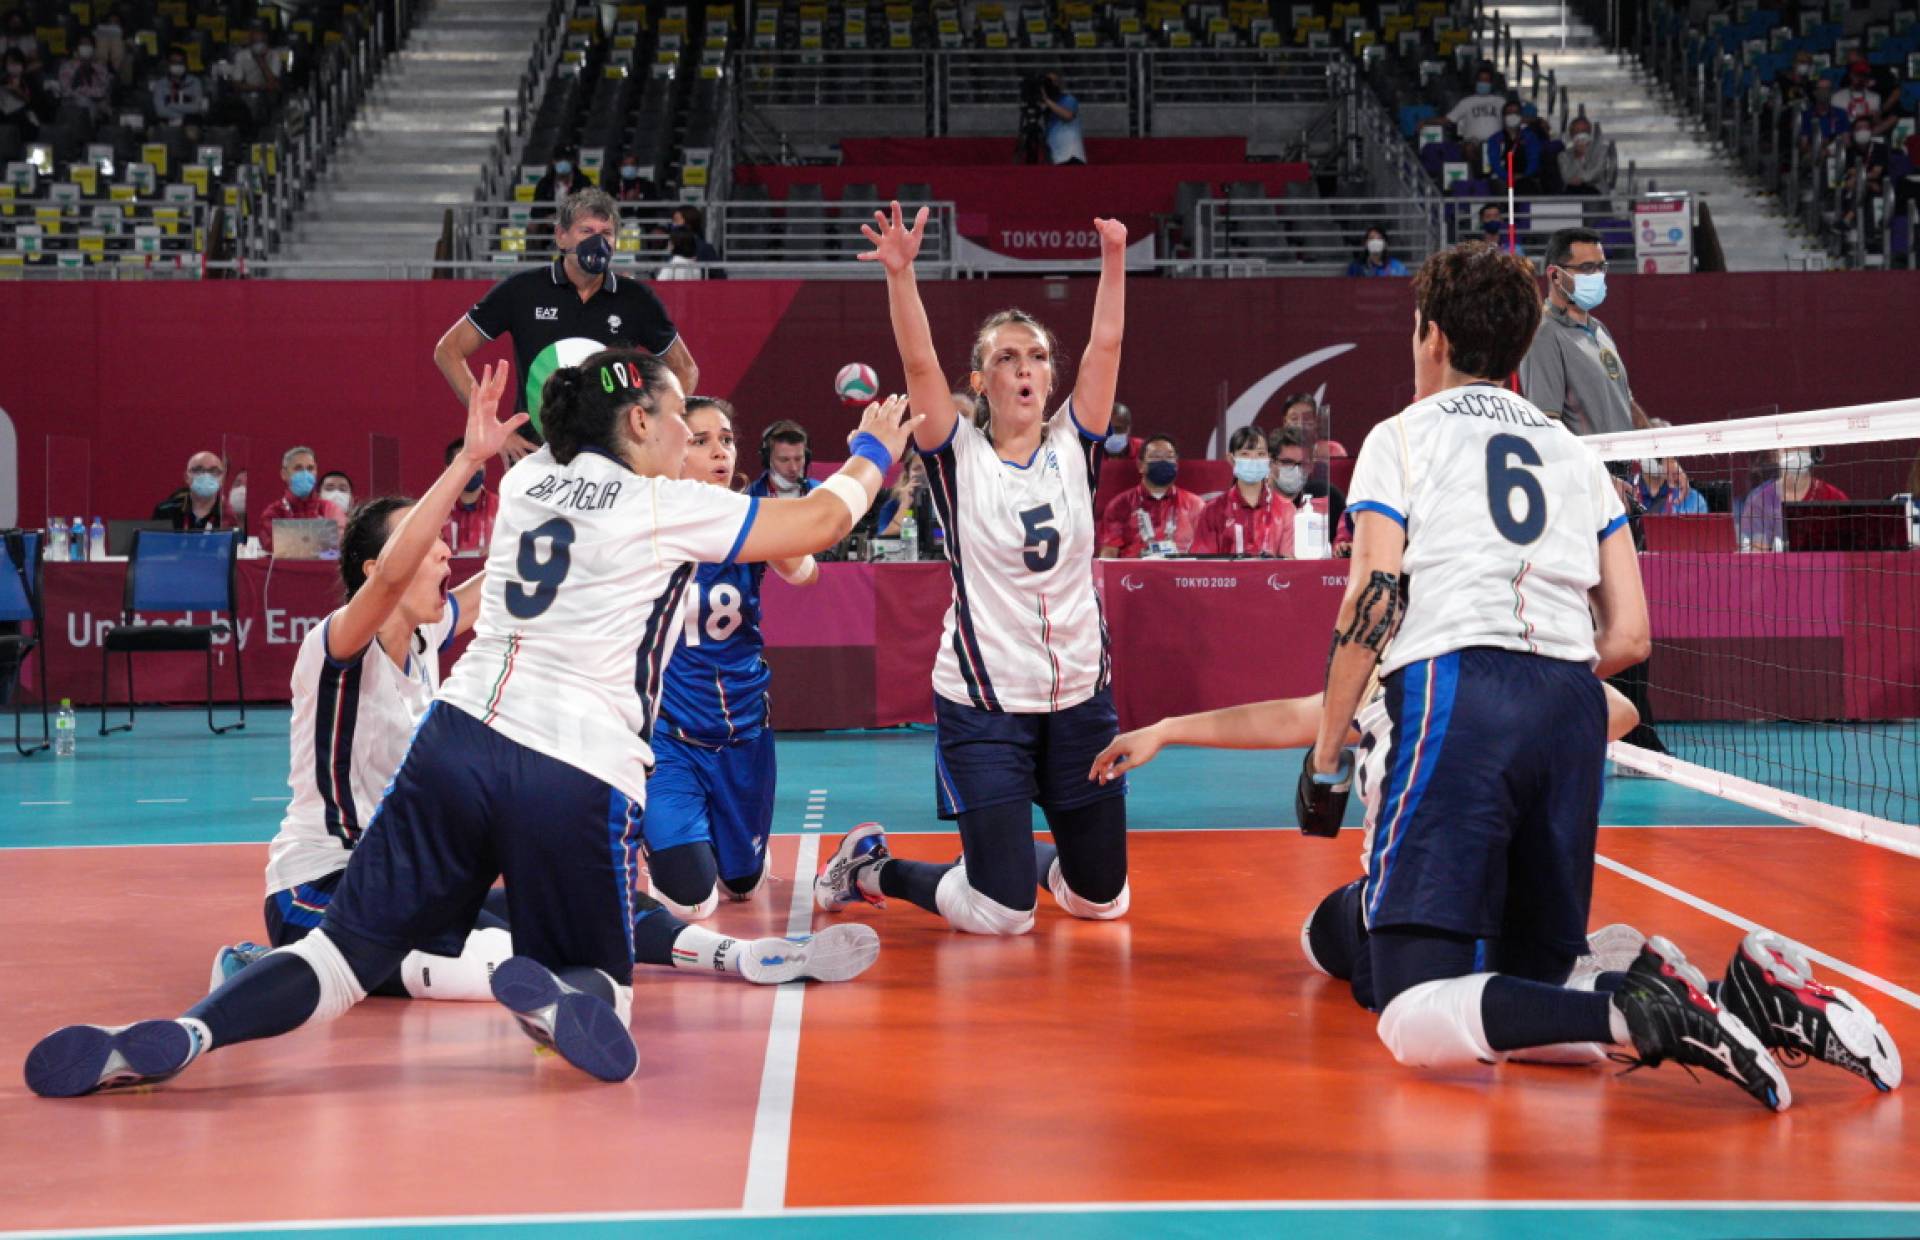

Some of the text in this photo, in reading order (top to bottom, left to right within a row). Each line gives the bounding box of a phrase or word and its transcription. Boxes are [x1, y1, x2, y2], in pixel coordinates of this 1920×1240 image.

[1472, 103, 1498, 117] USA
[1001, 231, 1101, 248] TOKYO 202
[535, 306, 558, 318] EA7
[1486, 432, 1547, 546] 6
[1019, 502, 1060, 573] 5
[505, 517, 576, 620] 9
[1175, 577, 1237, 589] TOKYO 2020
[1321, 575, 1349, 587] TOKY
[685, 582, 743, 648] 18
[211, 610, 253, 651] by
